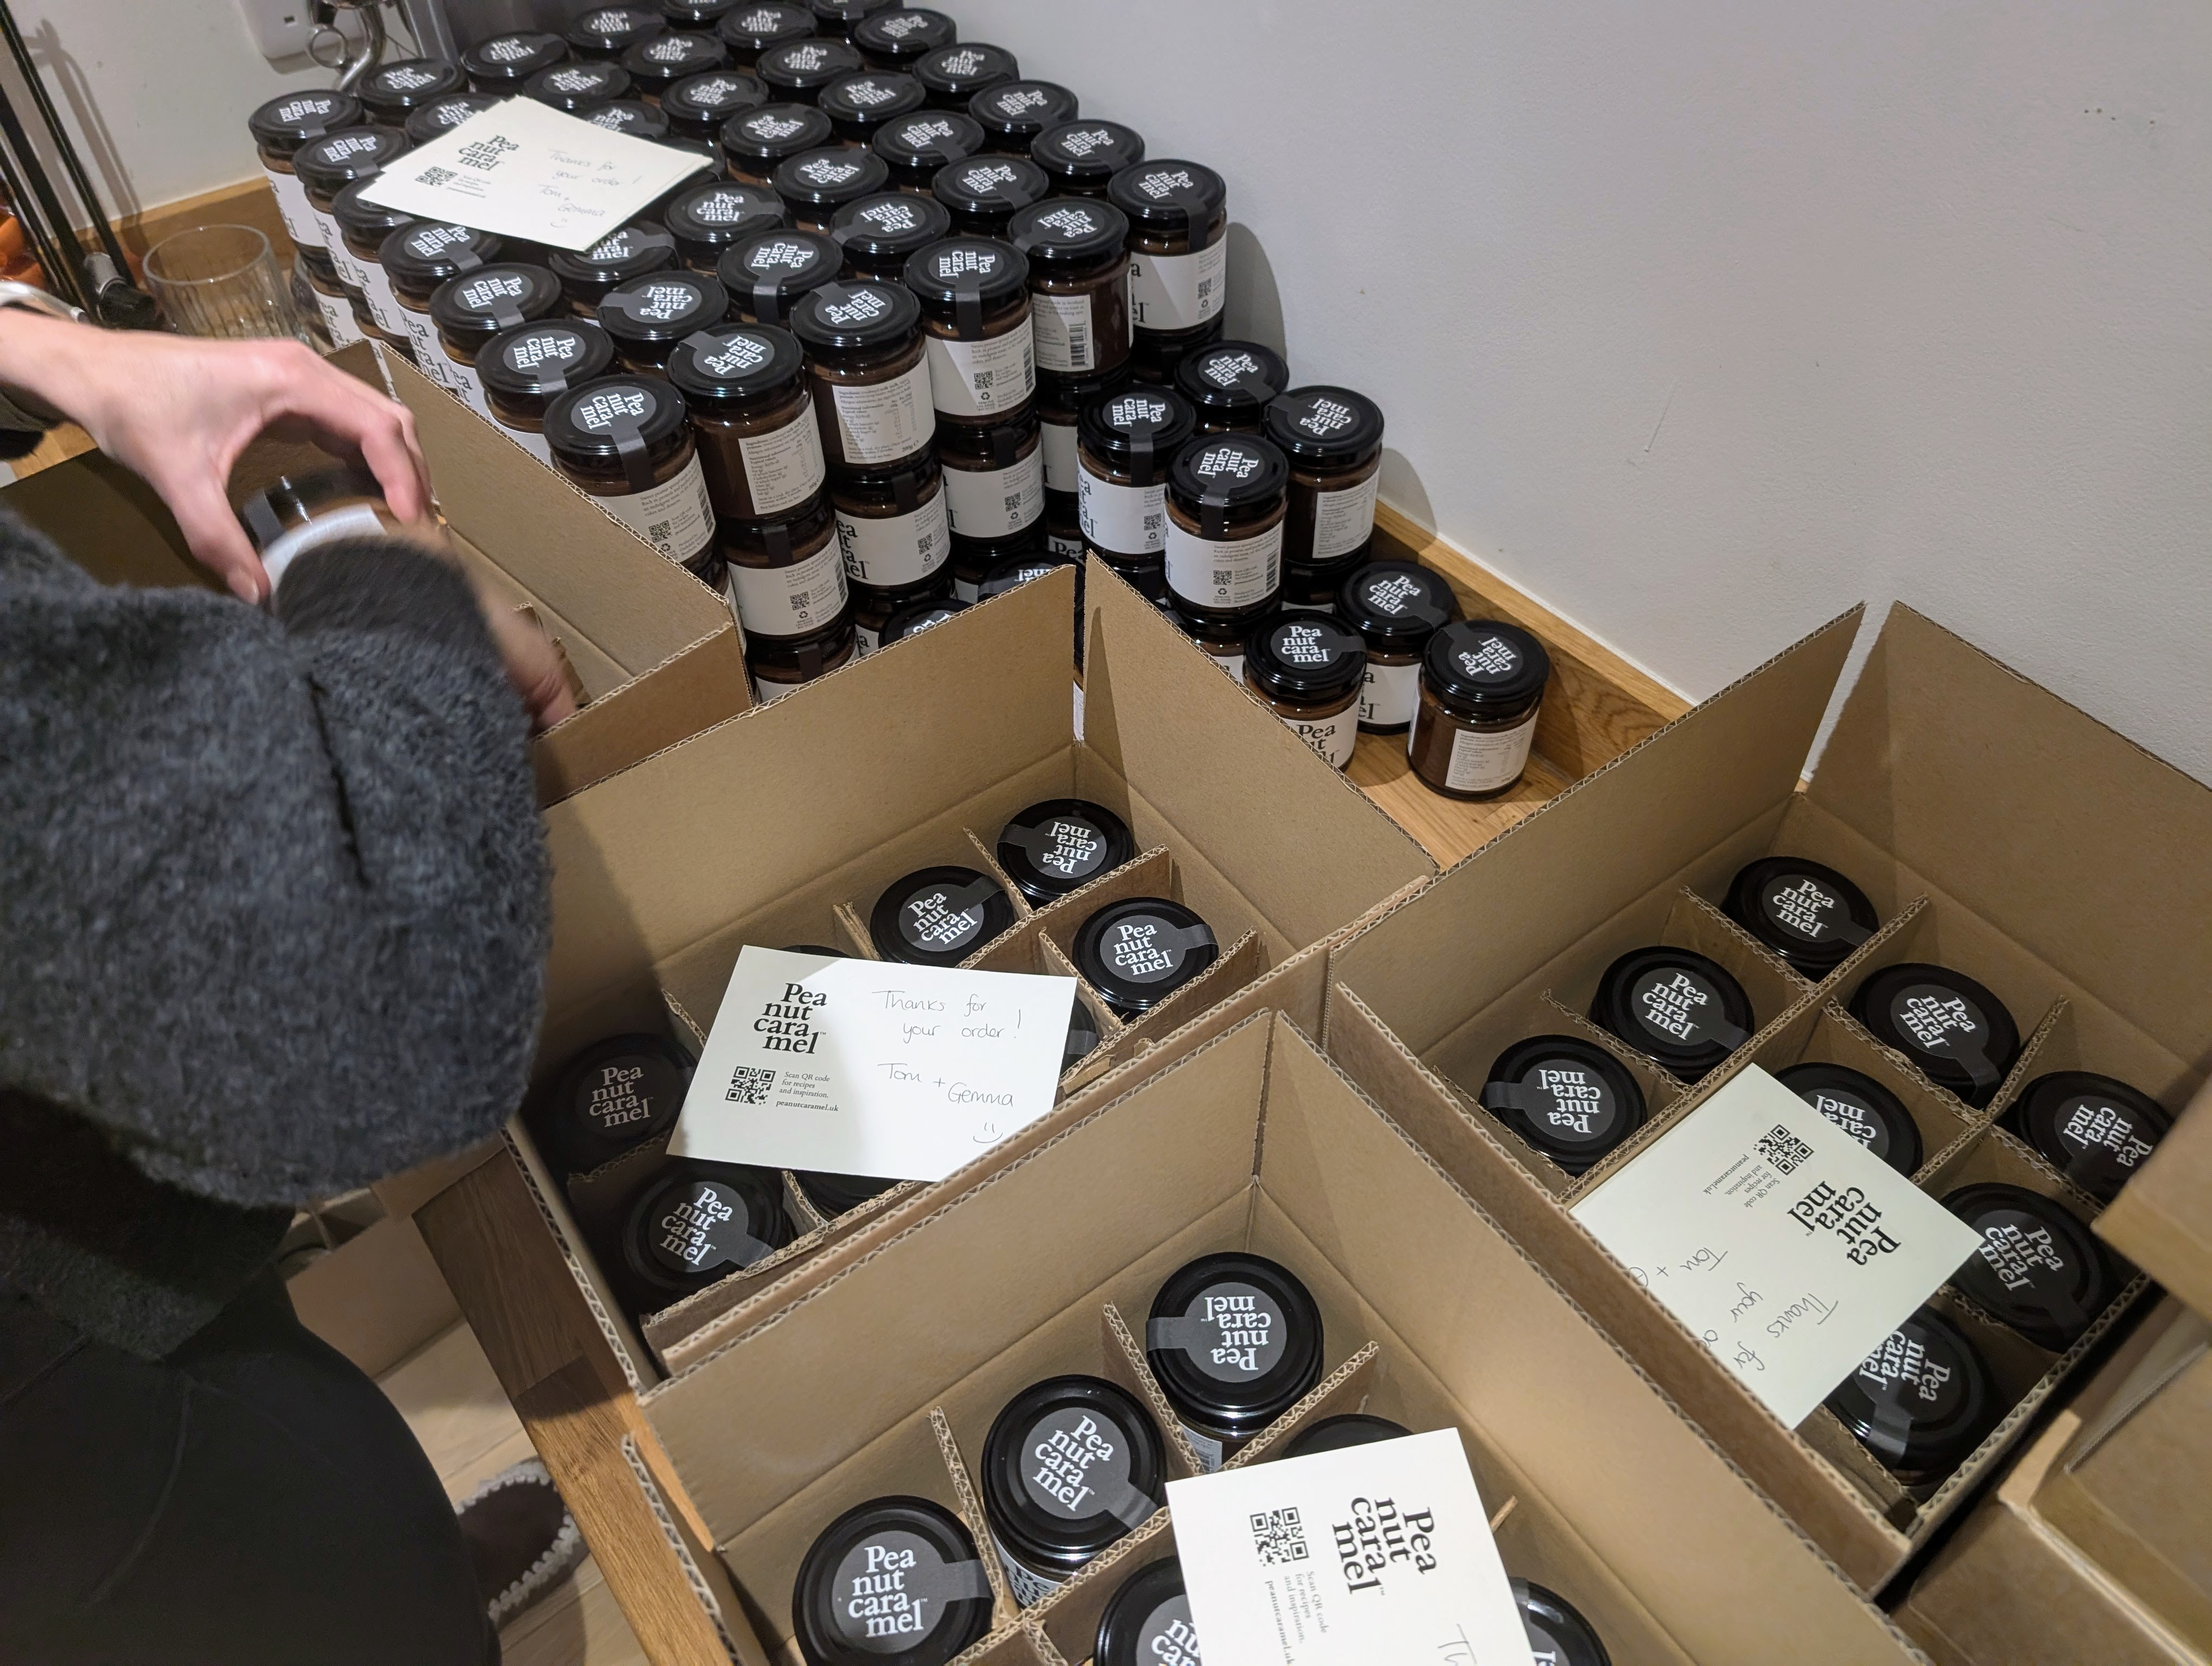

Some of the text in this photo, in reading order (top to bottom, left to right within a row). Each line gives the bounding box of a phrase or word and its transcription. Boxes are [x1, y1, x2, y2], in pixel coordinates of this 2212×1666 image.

[468, 142, 505, 156] nut
[486, 135, 519, 151] Pea
[458, 148, 497, 163] cara
[1144, 175, 1170, 193] cara
[1156, 172, 1180, 188] nut
[1171, 171, 1193, 188] Pea
[712, 194, 744, 203] Pea
[951, 251, 964, 272] cara
[965, 252, 979, 270] nut
[979, 255, 995, 274] Pea
[718, 353, 752, 368] nut
[728, 345, 763, 363] cara
[704, 356, 735, 375] Pea
[592, 396, 614, 421] cara
[607, 393, 629, 415] nut
[624, 393, 644, 416] Pea
[1212, 448, 1231, 471] cara
[1225, 451, 1243, 472] nut
[1236, 458, 1258, 478] Pea
[1369, 585, 1401, 605] cara
[1378, 580, 1409, 598] nut
[1392, 575, 1420, 596] Pea
[1282, 636, 1316, 646] nut
[1289, 626, 1322, 637] Pea
[1281, 645, 1320, 654] cara
[1482, 646, 1512, 671] cara
[1458, 652, 1484, 676] Pea
[1472, 652, 1500, 674] nut
[1296, 725, 1336, 739] Pea
[1053, 844, 1091, 861] nut
[1057, 834, 1097, 851] cara
[1043, 853, 1077, 873] Pea
[908, 893, 947, 918] Pea
[913, 905, 949, 932] nut
[921, 913, 961, 941] cara
[1117, 925, 1158, 941] Pea
[1113, 936, 1153, 954] nut
[1115, 948, 1160, 966] cara
[780, 983, 827, 1007] Pea
[1651, 983, 1694, 1011] nut
[1669, 972, 1707, 1005] Pea
[762, 1002, 813, 1021] nut
[872, 990, 986, 1016] Thanks for
[1642, 992, 1687, 1023] cara
[1920, 995, 1958, 1029] nut
[1906, 998, 1944, 1036] cara
[1941, 997, 1975, 1033] Pea
[753, 1018, 809, 1037] cara
[903, 1023, 941, 1043] your
[601, 1067, 644, 1086] Pea
[878, 1063, 1013, 1107] Tom + Gemma
[591, 1080, 634, 1103] nut
[793, 1088, 828, 1098] inspiration.
[1551, 1084, 1601, 1100] cara
[589, 1095, 639, 1116] cara
[776, 1100, 839, 1111] peanutcaramel.uk
[1556, 1099, 1600, 1114] nut
[1547, 1112, 1591, 1132] Pea
[1703, 1154, 1750, 1195] peanutcaramel.uk
[1724, 1165, 1763, 1195] and inspiration.
[1744, 1171, 1772, 1194] for recipes
[693, 1187, 732, 1221] Pea
[1744, 1178, 1780, 1208] Scan QR code
[673, 1202, 716, 1231] nut
[1814, 1186, 1866, 1231] cara
[661, 1215, 706, 1246] cara
[1836, 1202, 1882, 1245] nut
[1847, 1226, 1901, 1265] Pea
[1680, 1247, 1728, 1271] Tom
[1729, 1282, 1764, 1323] your
[1217, 1312, 1271, 1329] cara
[1733, 1292, 1839, 1371] Thanks for
[1221, 1330, 1269, 1348] nut
[1211, 1348, 1258, 1369] Pea
[1048, 1429, 1095, 1469] nut
[1070, 1415, 1113, 1461] Pea
[1034, 1443, 1084, 1488] cara
[1349, 1496, 1387, 1574] cara
[1374, 1496, 1412, 1564] nut
[1402, 1506, 1436, 1575] Pea
[864, 1546, 916, 1573] Pea
[852, 1569, 904, 1596] nut
[1284, 1575, 1296, 1592] and
[848, 1593, 910, 1618] cara
[1295, 1573, 1311, 1618] for recipes
[1306, 1571, 1329, 1633] Scan QR code
